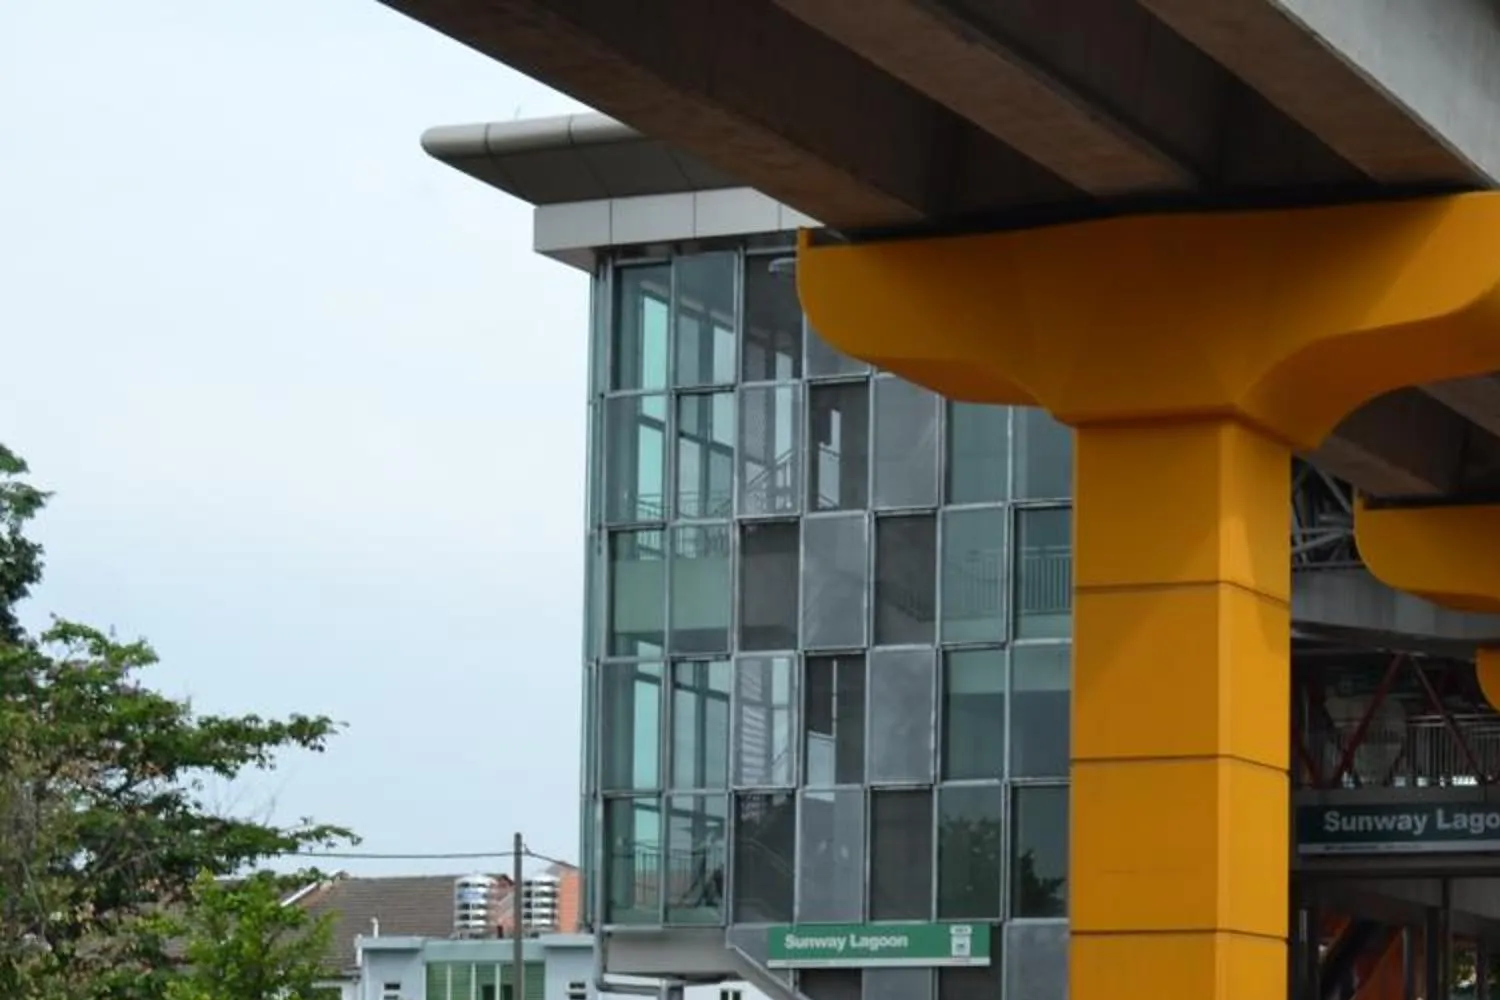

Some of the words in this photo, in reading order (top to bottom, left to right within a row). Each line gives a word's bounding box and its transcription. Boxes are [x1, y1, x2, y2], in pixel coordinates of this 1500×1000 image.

[1323, 810, 1428, 836] Sunway
[784, 934, 847, 951] Sunway
[850, 934, 909, 951] Lagoon
